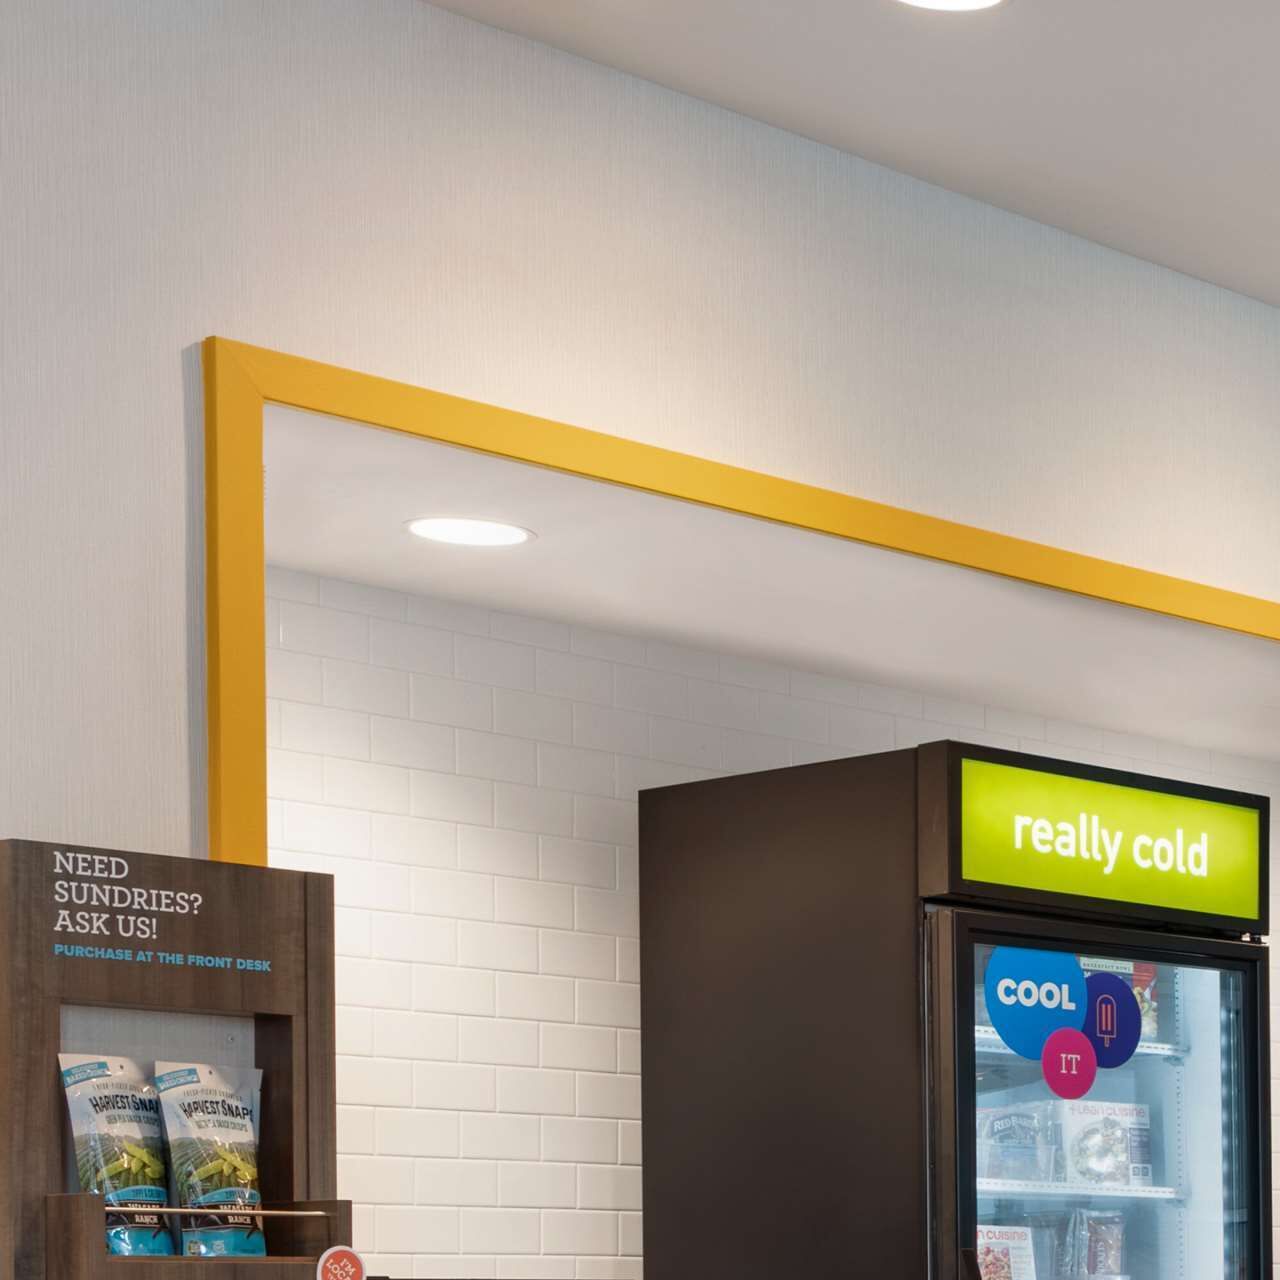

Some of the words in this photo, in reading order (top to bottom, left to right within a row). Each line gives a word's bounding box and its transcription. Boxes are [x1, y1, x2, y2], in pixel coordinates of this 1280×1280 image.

[1014, 812, 1123, 875] really
[1132, 828, 1209, 878] cold
[53, 851, 129, 879] NEED
[54, 880, 203, 915] SUNDRIES?
[54, 909, 110, 936] ASK
[116, 915, 158, 939] US!
[54, 943, 132, 961] PURCHASE
[136, 951, 154, 962] AT
[157, 952, 184, 965] THE
[188, 955, 233, 969] FRONT
[236, 959, 272, 972] DESK
[997, 978, 1076, 1011] COOL
[1059, 1054, 1081, 1075] IT
[135, 1214, 158, 1224] RANCH
